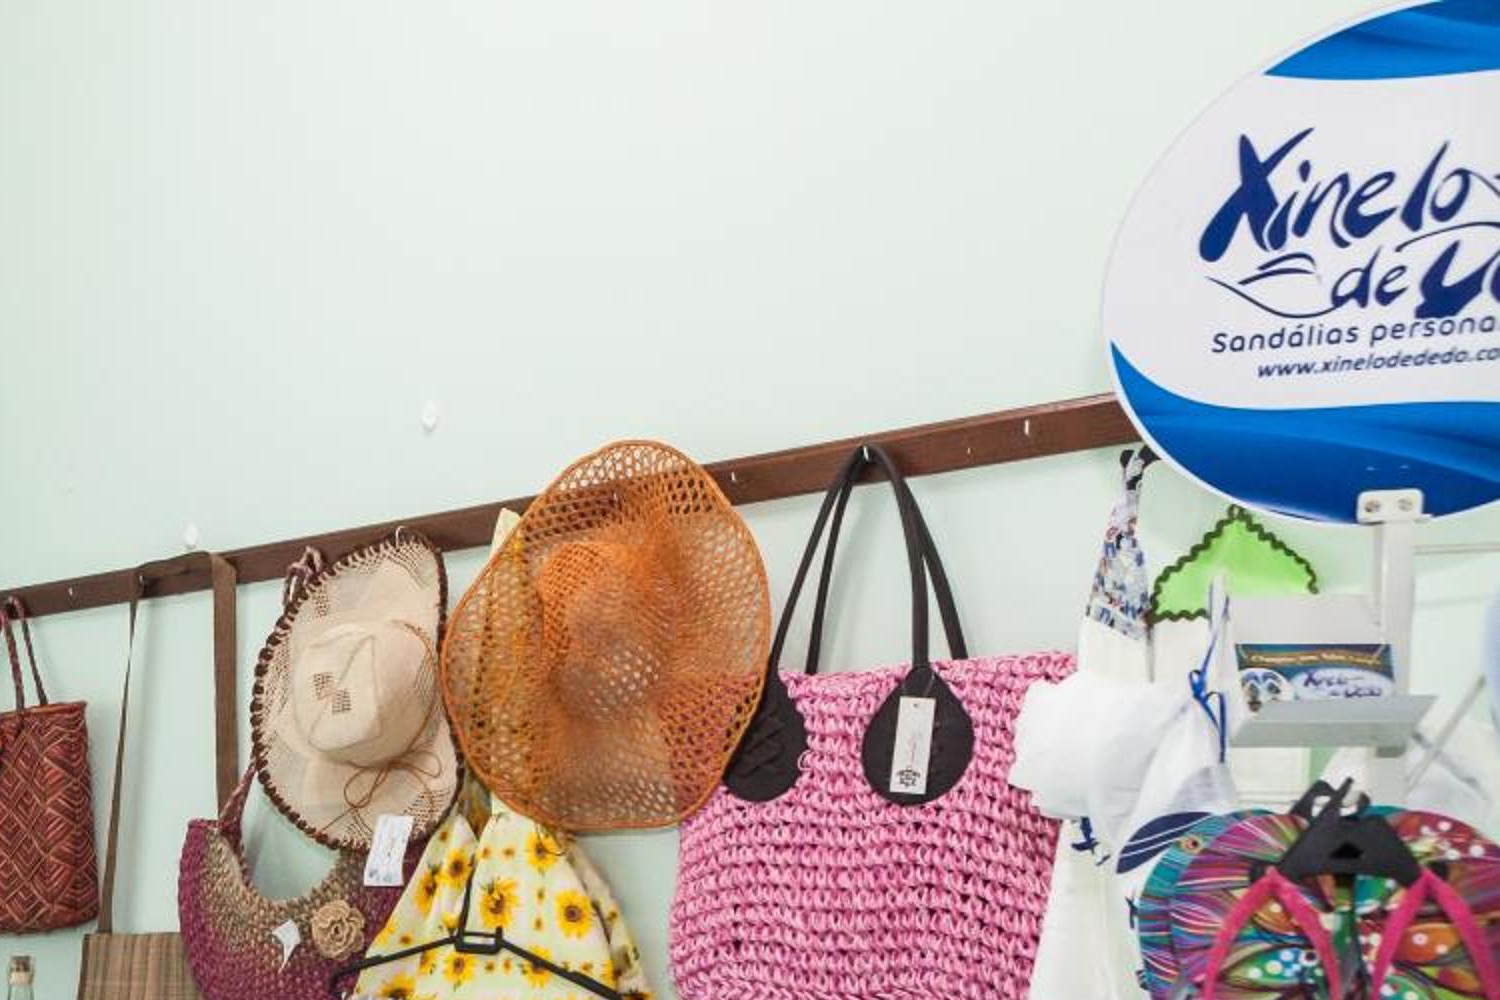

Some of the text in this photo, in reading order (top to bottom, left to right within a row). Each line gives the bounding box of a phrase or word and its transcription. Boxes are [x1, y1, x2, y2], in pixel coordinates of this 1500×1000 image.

[1199, 127, 1471, 262] Xinelo
[1331, 246, 1409, 309] de
[1211, 315, 1500, 354] Sandálias persona
[1257, 347, 1500, 378] www.xinelodededo.co
